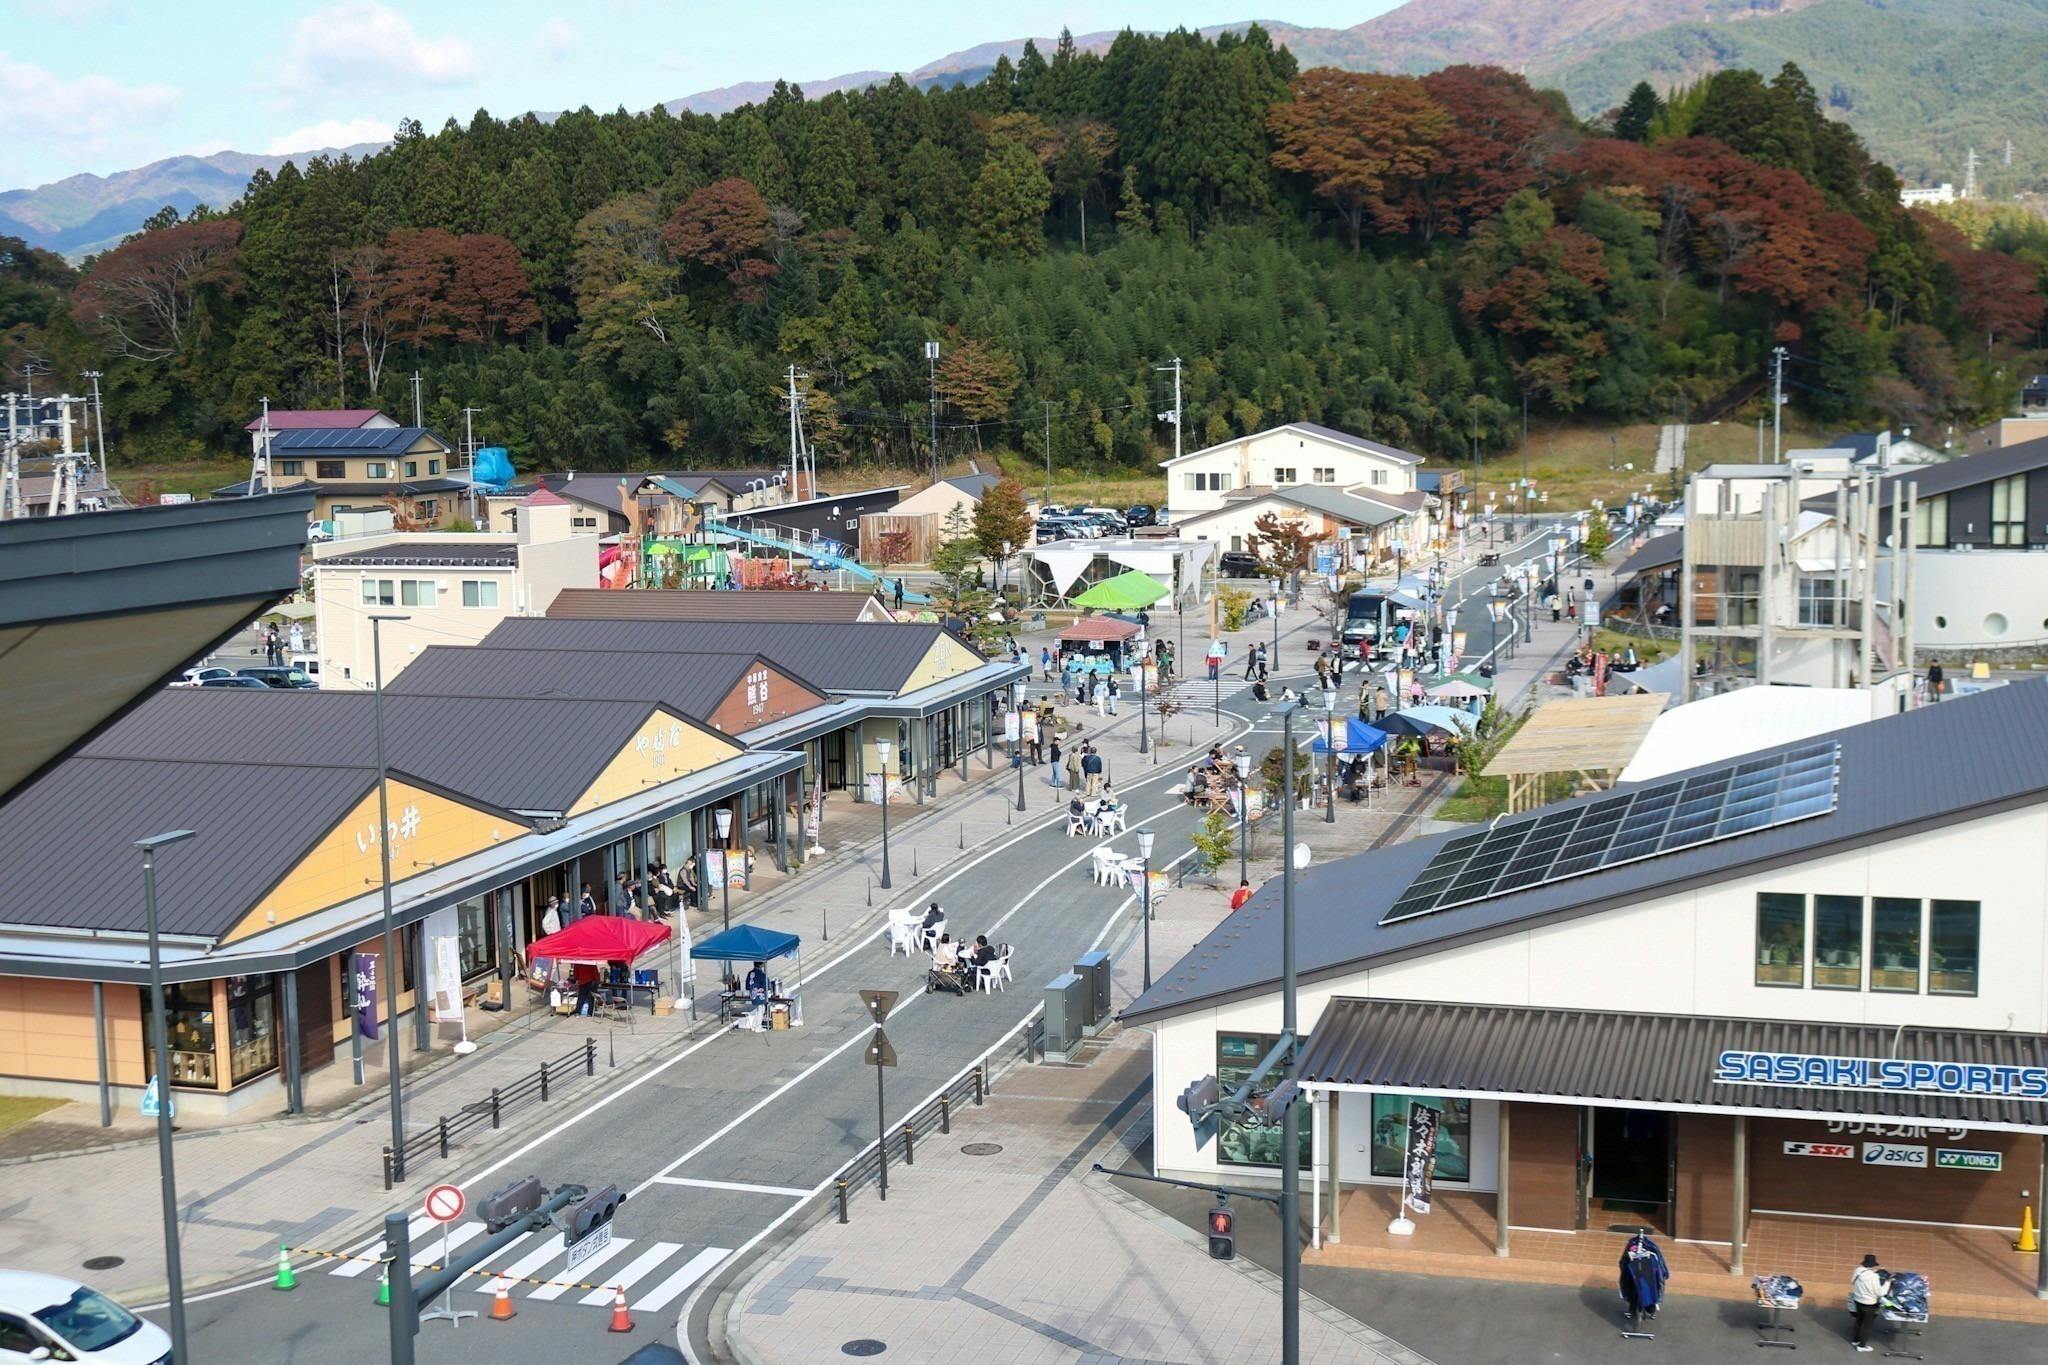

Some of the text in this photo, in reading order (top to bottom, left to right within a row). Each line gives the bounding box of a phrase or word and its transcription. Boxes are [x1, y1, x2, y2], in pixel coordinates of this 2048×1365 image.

[1720, 1051, 2048, 1097] SASAKI SPORTS
[1808, 1144, 1851, 1157] SSK
[1961, 1153, 1997, 1168] YONEX
